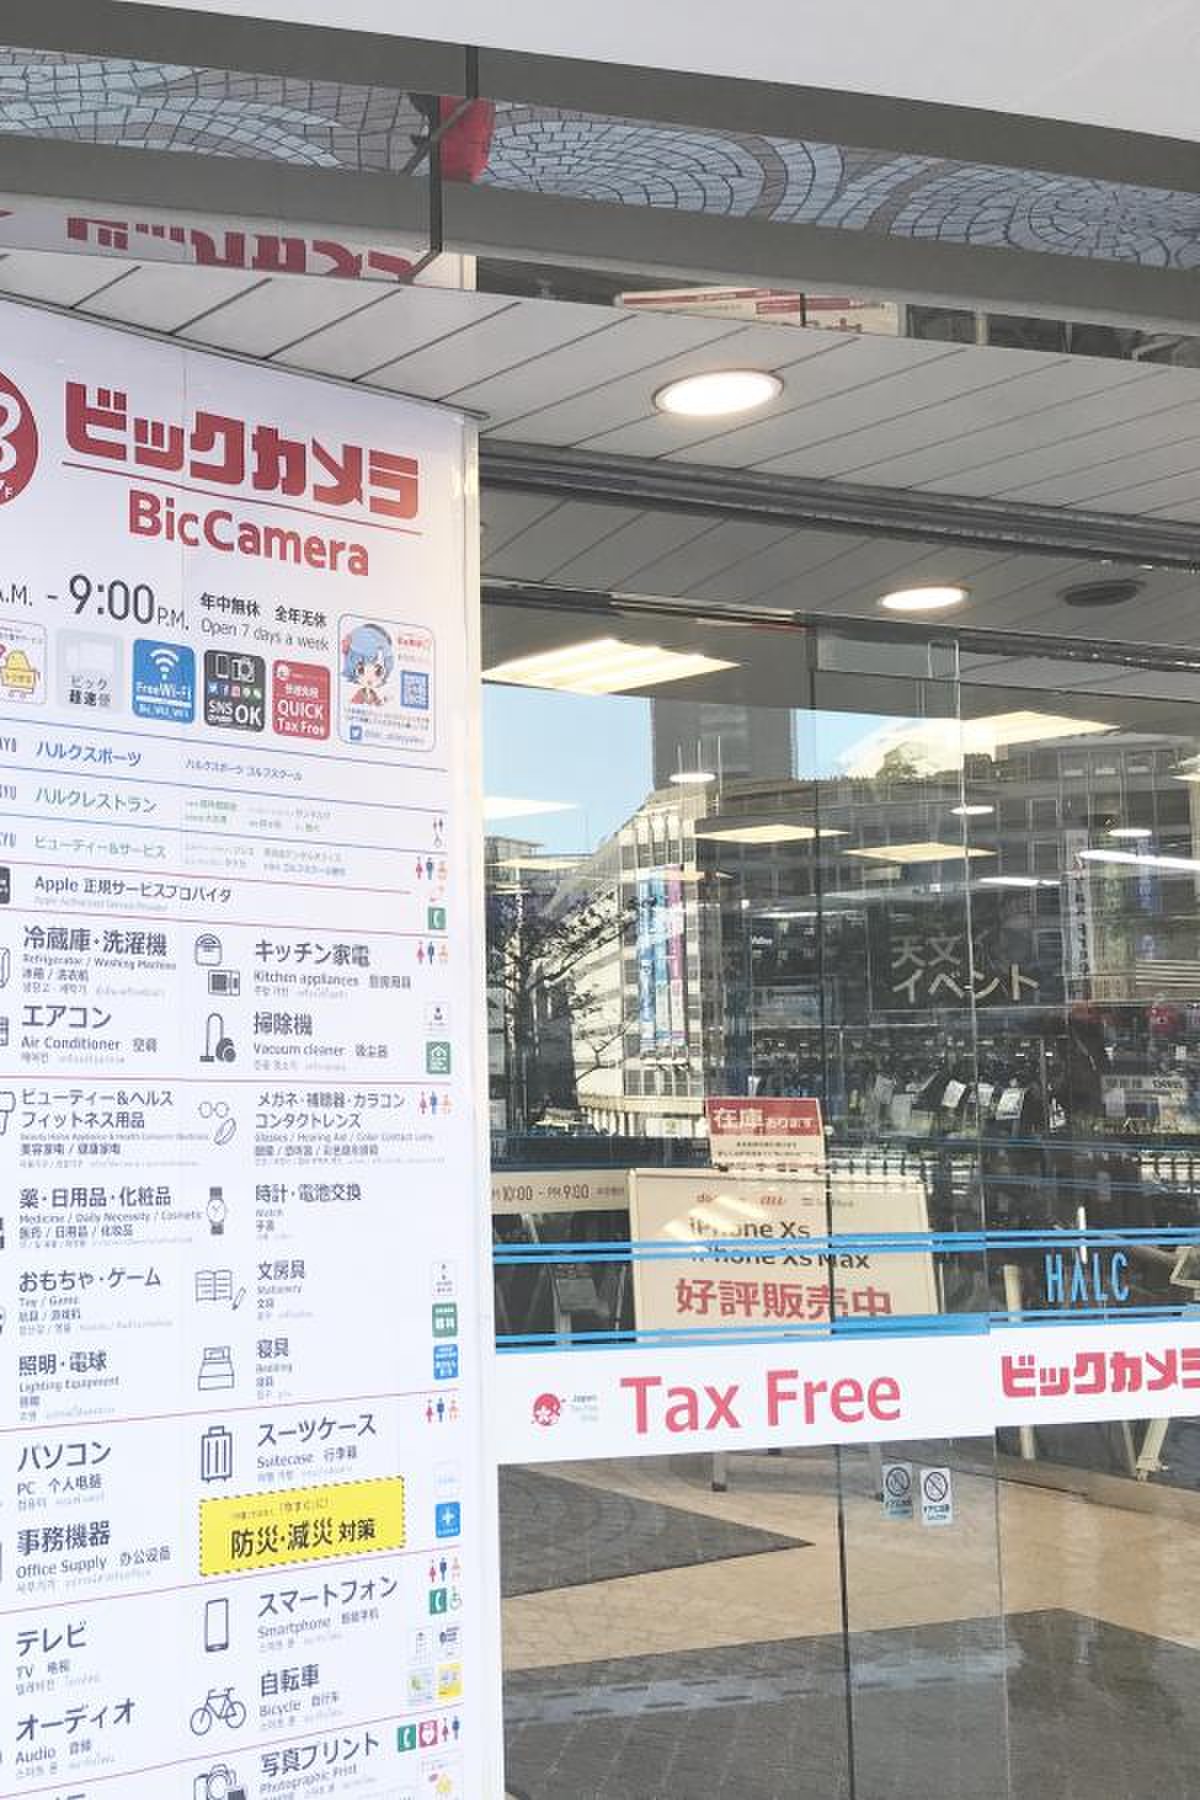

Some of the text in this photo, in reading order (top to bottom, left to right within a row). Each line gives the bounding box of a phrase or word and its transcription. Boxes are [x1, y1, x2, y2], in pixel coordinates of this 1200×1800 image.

[66, 381, 418, 519] ビックカメラ
[128, 489, 369, 577] BicCamera
[200, 591, 261, 617] 年中無休
[201, 618, 237, 638] Open
[240, 623, 250, 638] 7
[254, 626, 281, 646] days
[298, 634, 329, 651] week
[235, 704, 262, 726] OK
[277, 699, 324, 721] QUICK
[277, 718, 298, 733] Tax
[36, 741, 142, 767] ハルクスポーツ
[36, 787, 157, 814] ハルクレストラン
[34, 876, 78, 894] Apple
[23, 925, 167, 957] 冷蔵庫・洗濯機
[255, 939, 370, 968] キッチン家電
[254, 970, 296, 984] Kitchen
[892, 963, 1039, 1004] イベント
[22, 1005, 112, 1029] エアコン
[254, 1011, 313, 1036] 掃除機
[21, 1036, 121, 1052] Air Conditioner
[22, 1088, 174, 1106] ビューティー&ヘルス
[21, 1111, 145, 1129] フィットネス用品
[255, 1113, 362, 1129] コンタクトレンズ
[20, 1187, 171, 1208] 薬・日用品・化粧品
[255, 1183, 362, 1203] 時計・電池交換
[780, 1221, 810, 1239] Xs
[19, 1267, 161, 1294] おもちゃ・ゲーム
[257, 1259, 305, 1281] 文房具
[675, 1278, 893, 1320] 好評販売中
[256, 1337, 289, 1359] 寝具
[19, 1351, 107, 1376] 照明・電球
[619, 1369, 901, 1436] Tax Free
[257, 1414, 376, 1447] スーツケース
[17, 1441, 111, 1472] パソコン
[17, 1481, 36, 1496] PC
[17, 1520, 110, 1556] 事務機器
[231, 1518, 376, 1560] 防災・減災 対策
[16, 1556, 107, 1579] Office Supply
[258, 1575, 397, 1618] スマートフォン
[16, 1620, 87, 1657] テレビ
[257, 1616, 331, 1640] Smartphone
[16, 1664, 34, 1680] TV
[260, 1663, 319, 1697] 自転車
[16, 1698, 135, 1743] オーディオ
[259, 1700, 301, 1718] Bicycle
[16, 1746, 56, 1765] Audio
[260, 1732, 379, 1777] 写真プリント
